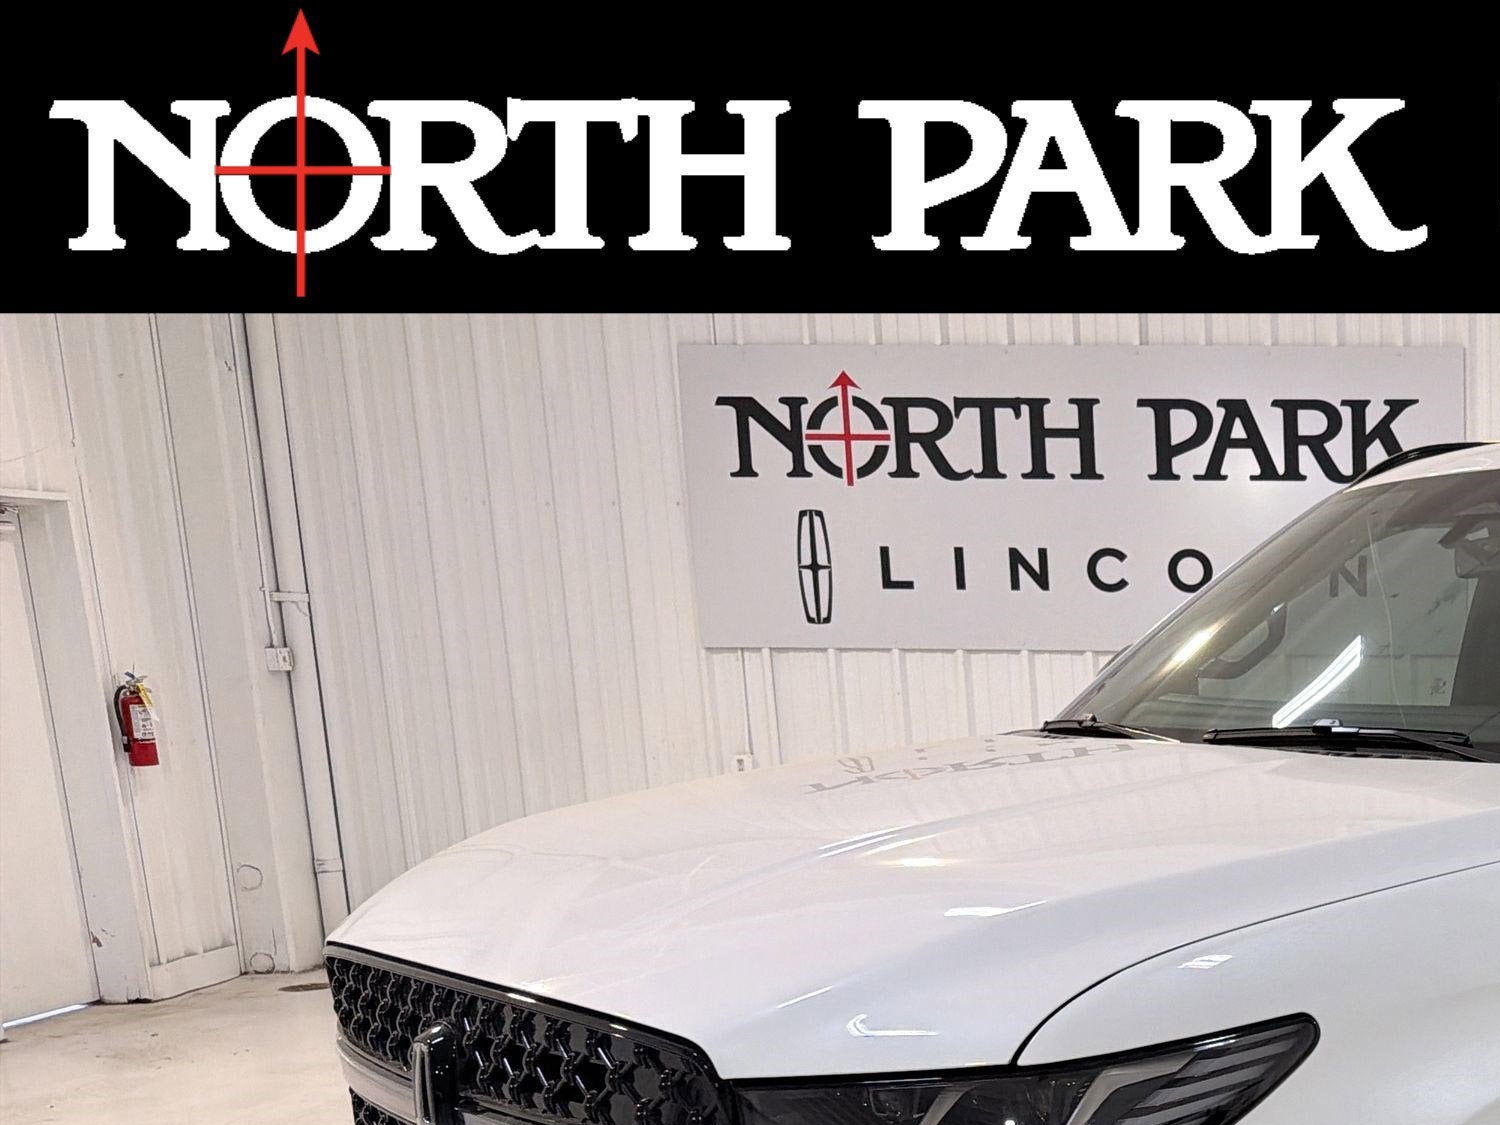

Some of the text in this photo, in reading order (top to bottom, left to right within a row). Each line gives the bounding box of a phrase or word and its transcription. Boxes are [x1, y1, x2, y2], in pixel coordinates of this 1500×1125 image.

[715, 396, 1419, 484] NORTH PARK
[880, 545, 1368, 599] LINCON
